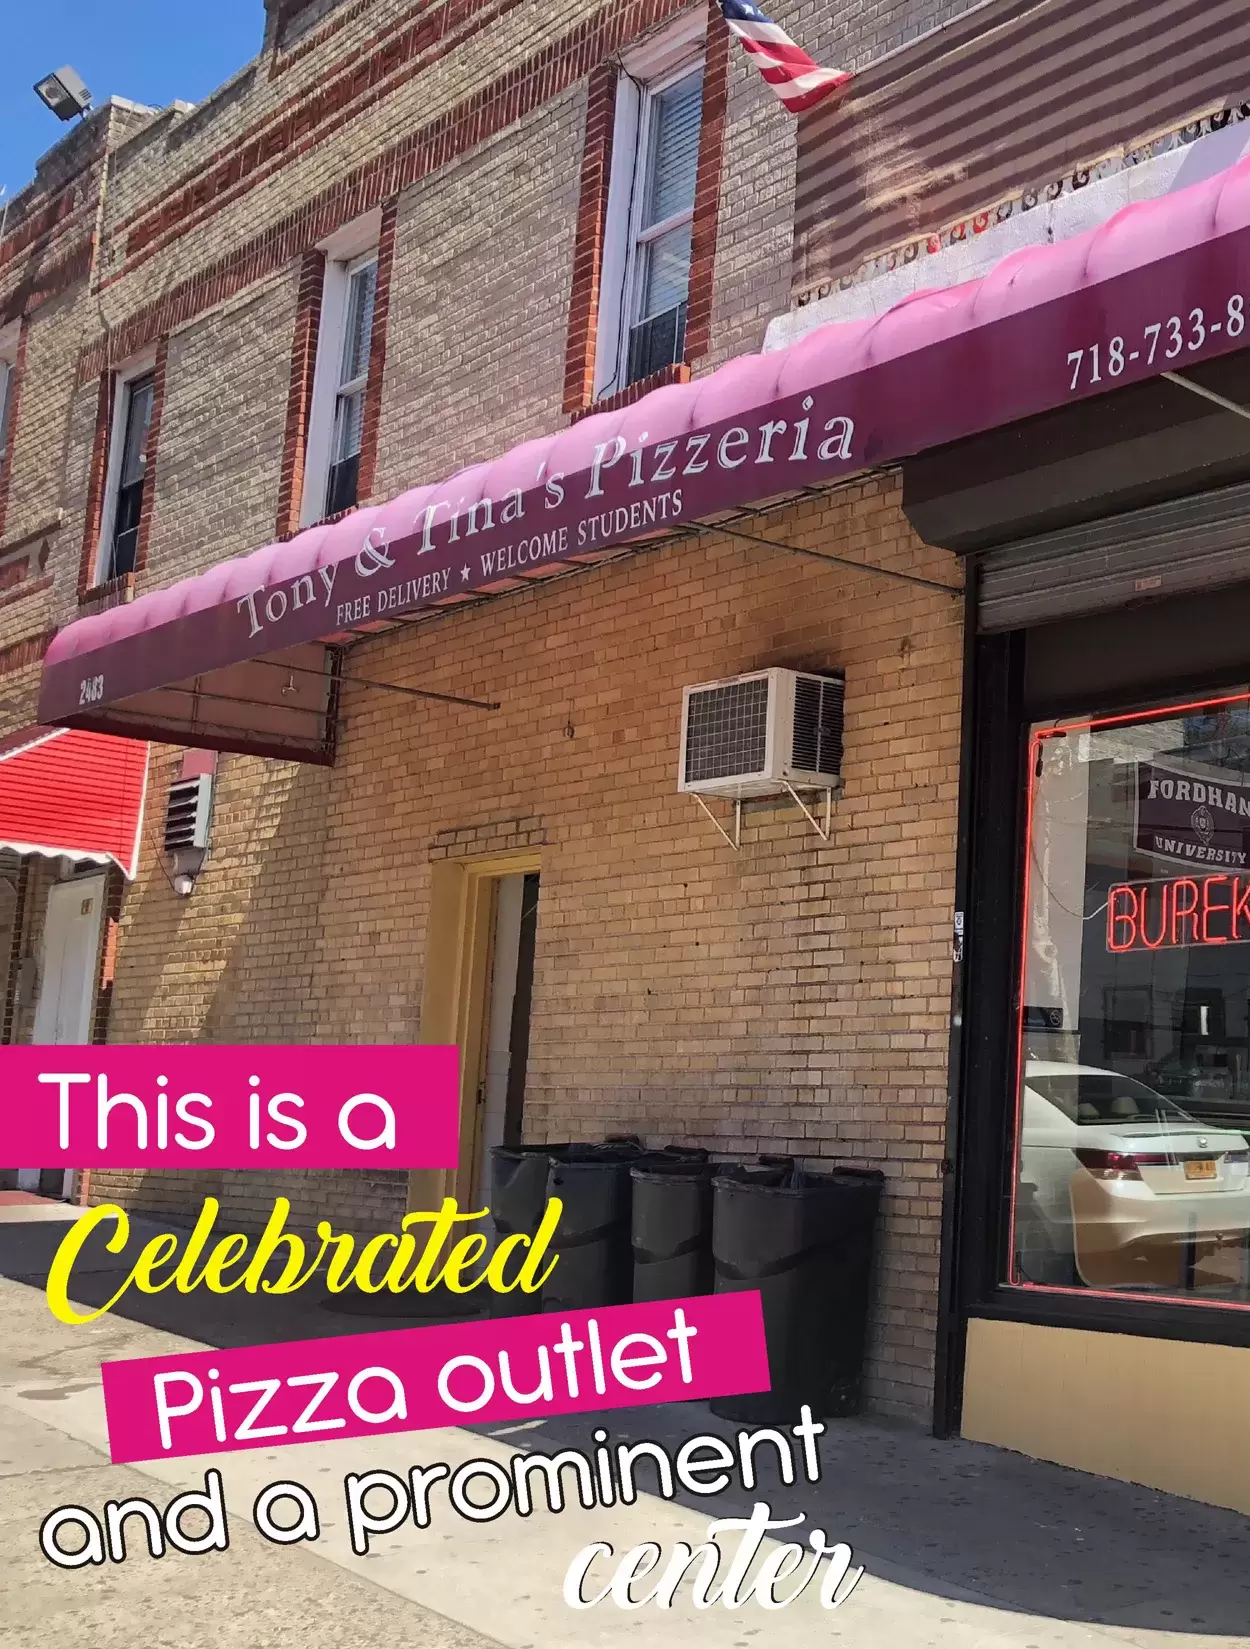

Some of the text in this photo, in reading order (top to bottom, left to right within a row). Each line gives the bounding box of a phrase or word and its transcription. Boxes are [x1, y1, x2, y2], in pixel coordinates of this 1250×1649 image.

[236, 395, 857, 640] Tony & Tina's Pizzeria
[336, 488, 683, 626] FREE DELIVERY WELCOME STUDENTS
[78, 674, 104, 706] 2483
[1155, 836, 1247, 864] UNIVERSITY
